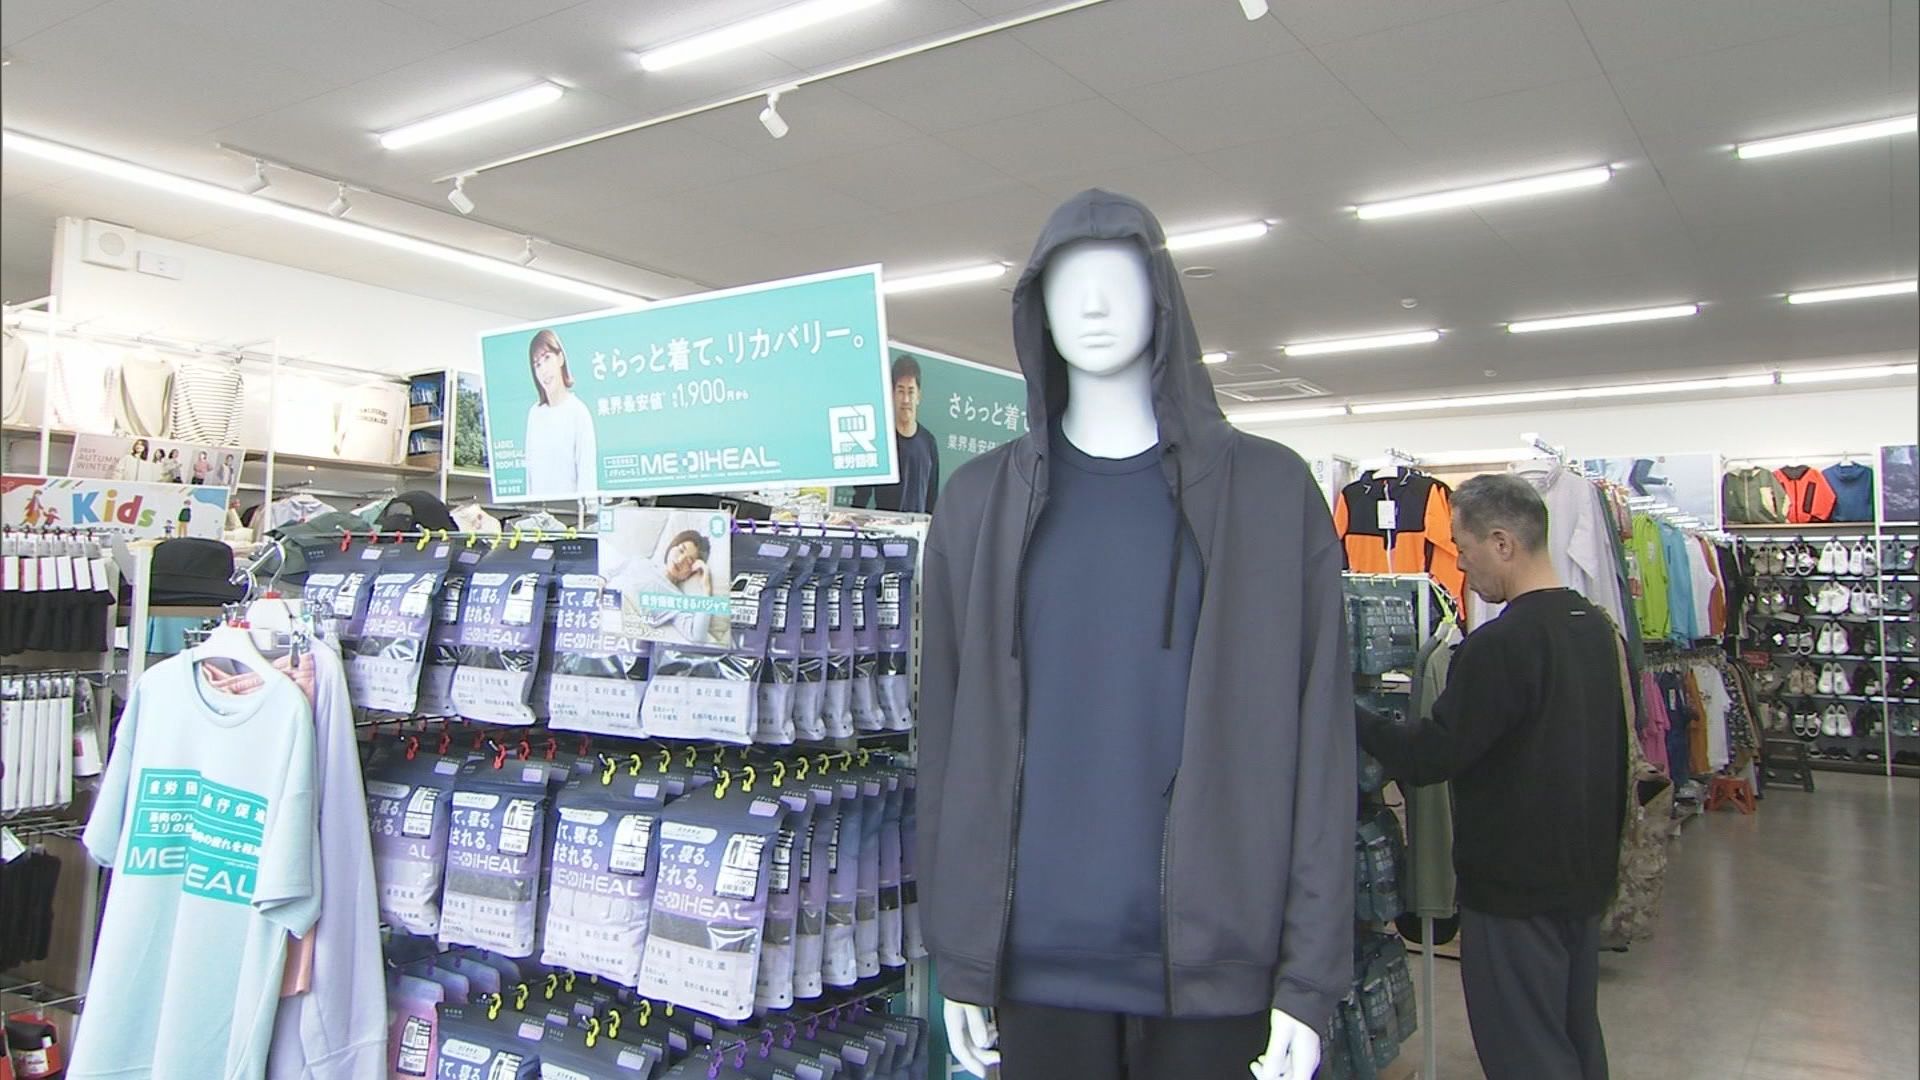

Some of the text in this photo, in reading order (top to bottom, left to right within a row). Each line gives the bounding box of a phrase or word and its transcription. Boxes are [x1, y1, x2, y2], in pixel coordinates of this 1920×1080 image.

[590, 319, 865, 381] さらっと着て、リカバリー。
[72, 489, 156, 527] Kids
